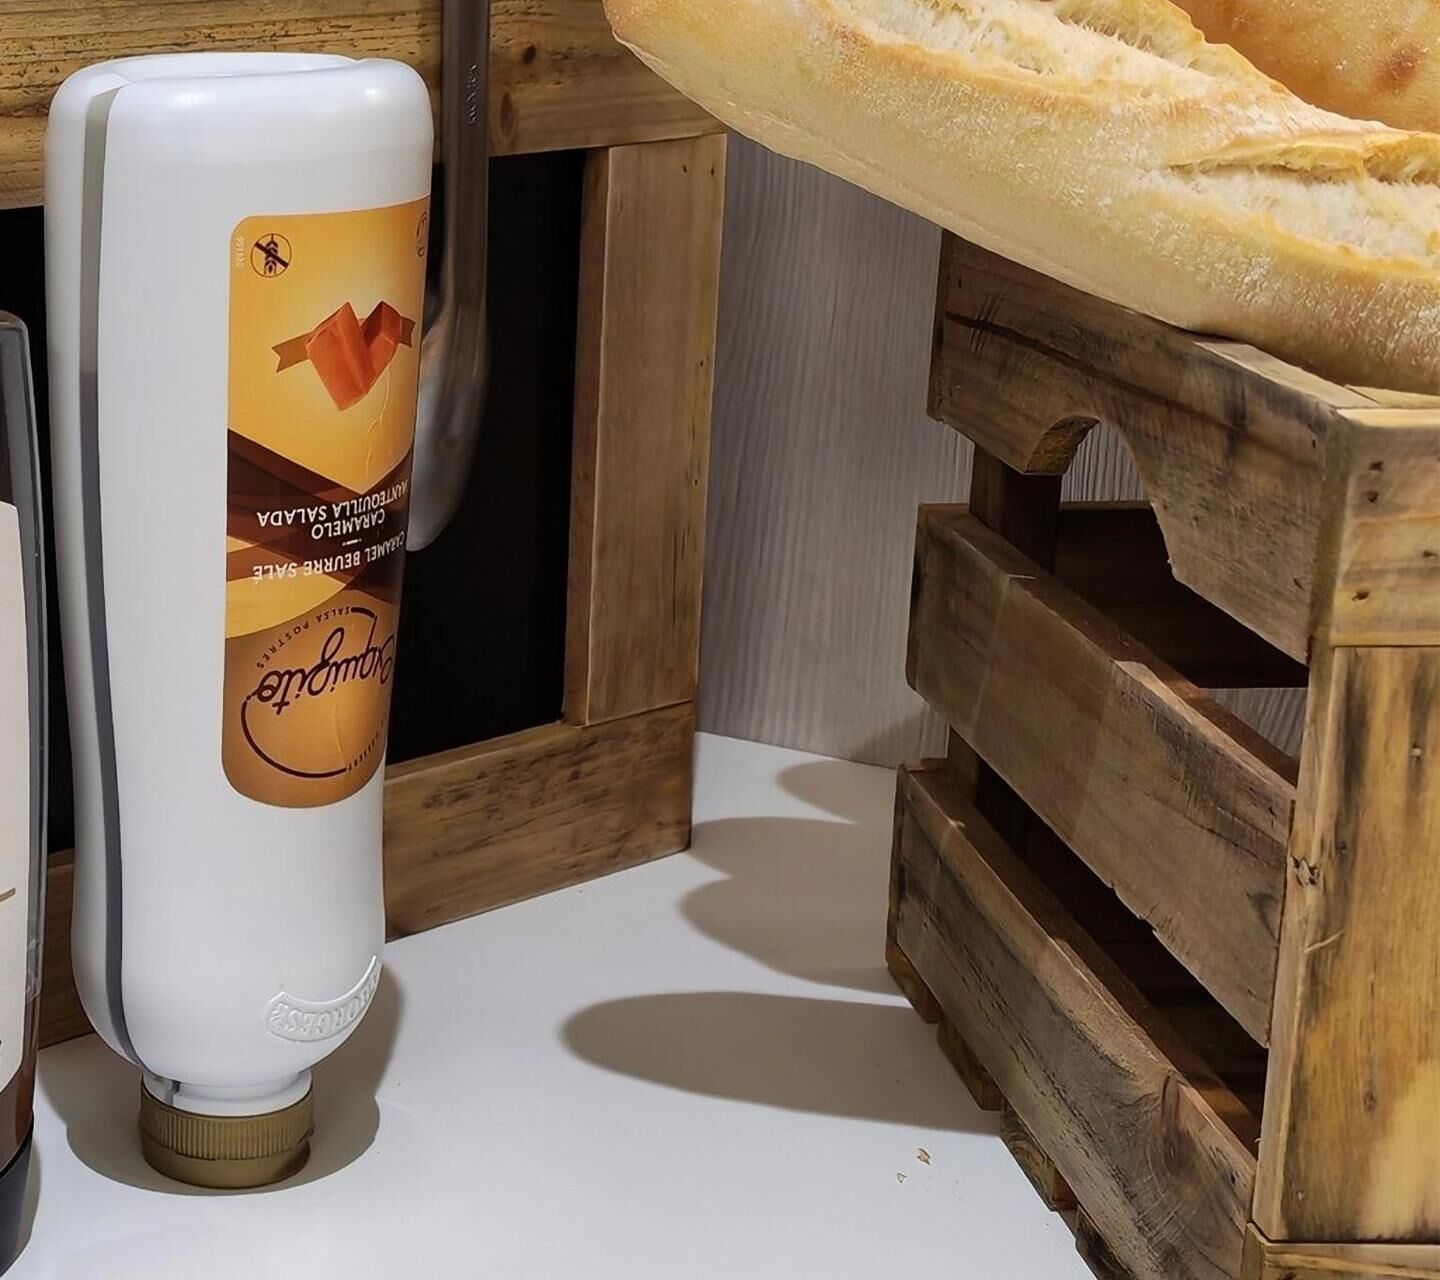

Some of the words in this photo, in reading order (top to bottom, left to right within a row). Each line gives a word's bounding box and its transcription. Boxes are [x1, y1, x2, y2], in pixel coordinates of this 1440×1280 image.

[256, 505, 327, 527] SALADA
[310, 508, 386, 540] CARAMELO
[364, 531, 405, 562] CARAMEL
[252, 562, 298, 585] SALÉ
[303, 550, 360, 576] BEURRE
[315, 606, 351, 623] SALSA
[255, 622, 309, 669] POSTRES
